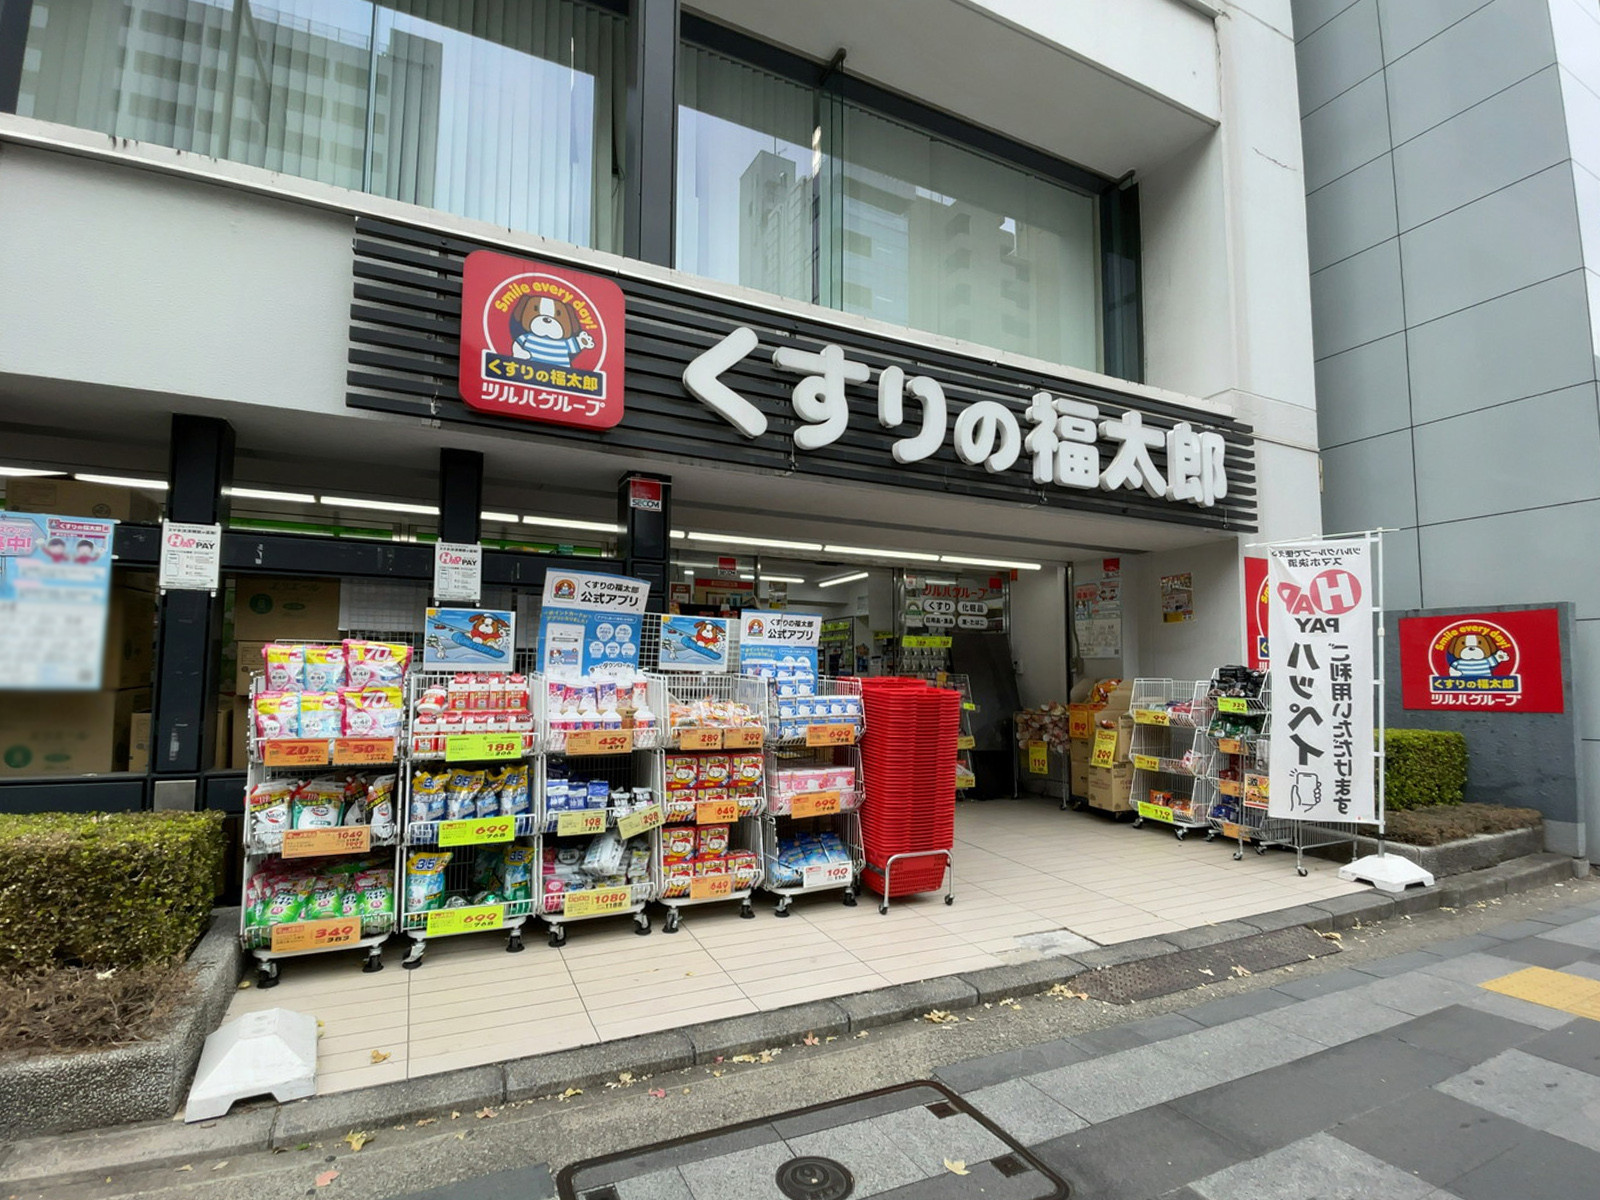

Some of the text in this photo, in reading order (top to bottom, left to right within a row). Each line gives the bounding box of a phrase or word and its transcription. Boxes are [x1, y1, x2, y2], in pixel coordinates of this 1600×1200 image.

[494, 281, 598, 330] Smile every day!
[488, 359, 598, 392] くすりの福太郎
[481, 382, 606, 417] ツルハグループ
[682, 325, 1228, 508] くすりの福太郎
[632, 499, 660, 509] SECOM
[584, 580, 640, 594] くすりの福太郎
[581, 591, 639, 607] 公式アプリ
[928, 601, 951, 611] くすり
[962, 603, 984, 613] 化粧品
[768, 629, 814, 640] 公式アプリ
[1435, 625, 1511, 652] Smile every day!
[364, 646, 391, 660] 70
[1434, 678, 1515, 690] くすりの福太郎
[361, 693, 387, 708] 70
[1431, 694, 1522, 706] ツルハグループ
[1074, 723, 1087, 731] 89
[598, 737, 627, 745] 429
[701, 734, 719, 742] 289
[744, 733, 760, 741] 299
[487, 743, 515, 751] 188
[814, 799, 837, 807] 699
[716, 807, 735, 815] 649
[584, 818, 601, 827] 198
[643, 812, 660, 823] 298
[476, 825, 509, 834] 699
[337, 831, 363, 839] 1049
[827, 868, 848, 876] 100
[711, 881, 728, 890] 649
[595, 893, 627, 904] 1080
[464, 913, 497, 923] 699
[315, 926, 353, 939] 349
[327, 935, 350, 943] 383
